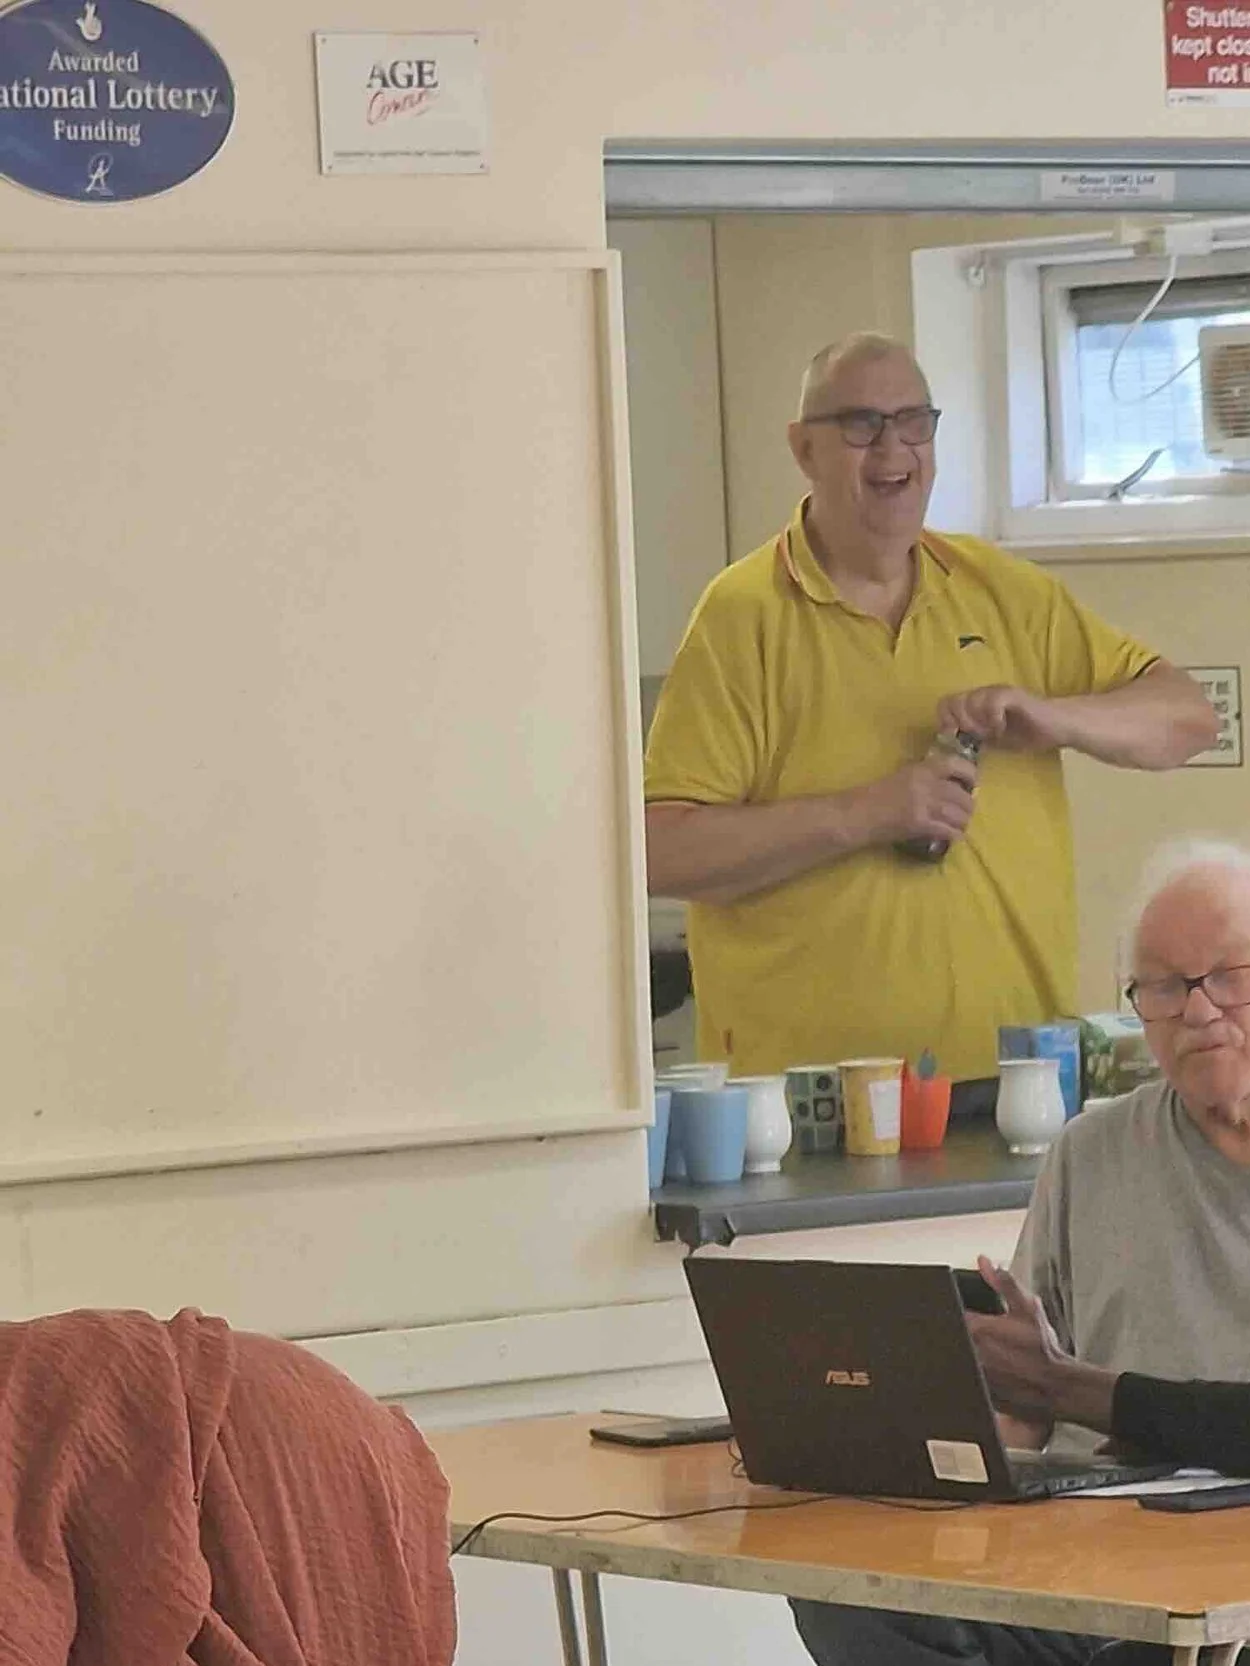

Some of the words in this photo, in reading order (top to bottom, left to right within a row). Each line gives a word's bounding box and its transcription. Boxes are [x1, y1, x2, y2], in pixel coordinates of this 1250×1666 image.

[48, 49, 140, 72] Awarded
[1171, 34, 1213, 61] kept
[366, 59, 439, 89] AGE
[1207, 62, 1239, 84] not
[0, 76, 98, 109] ational
[107, 79, 218, 118] Lottery
[53, 119, 141, 147] Funding
